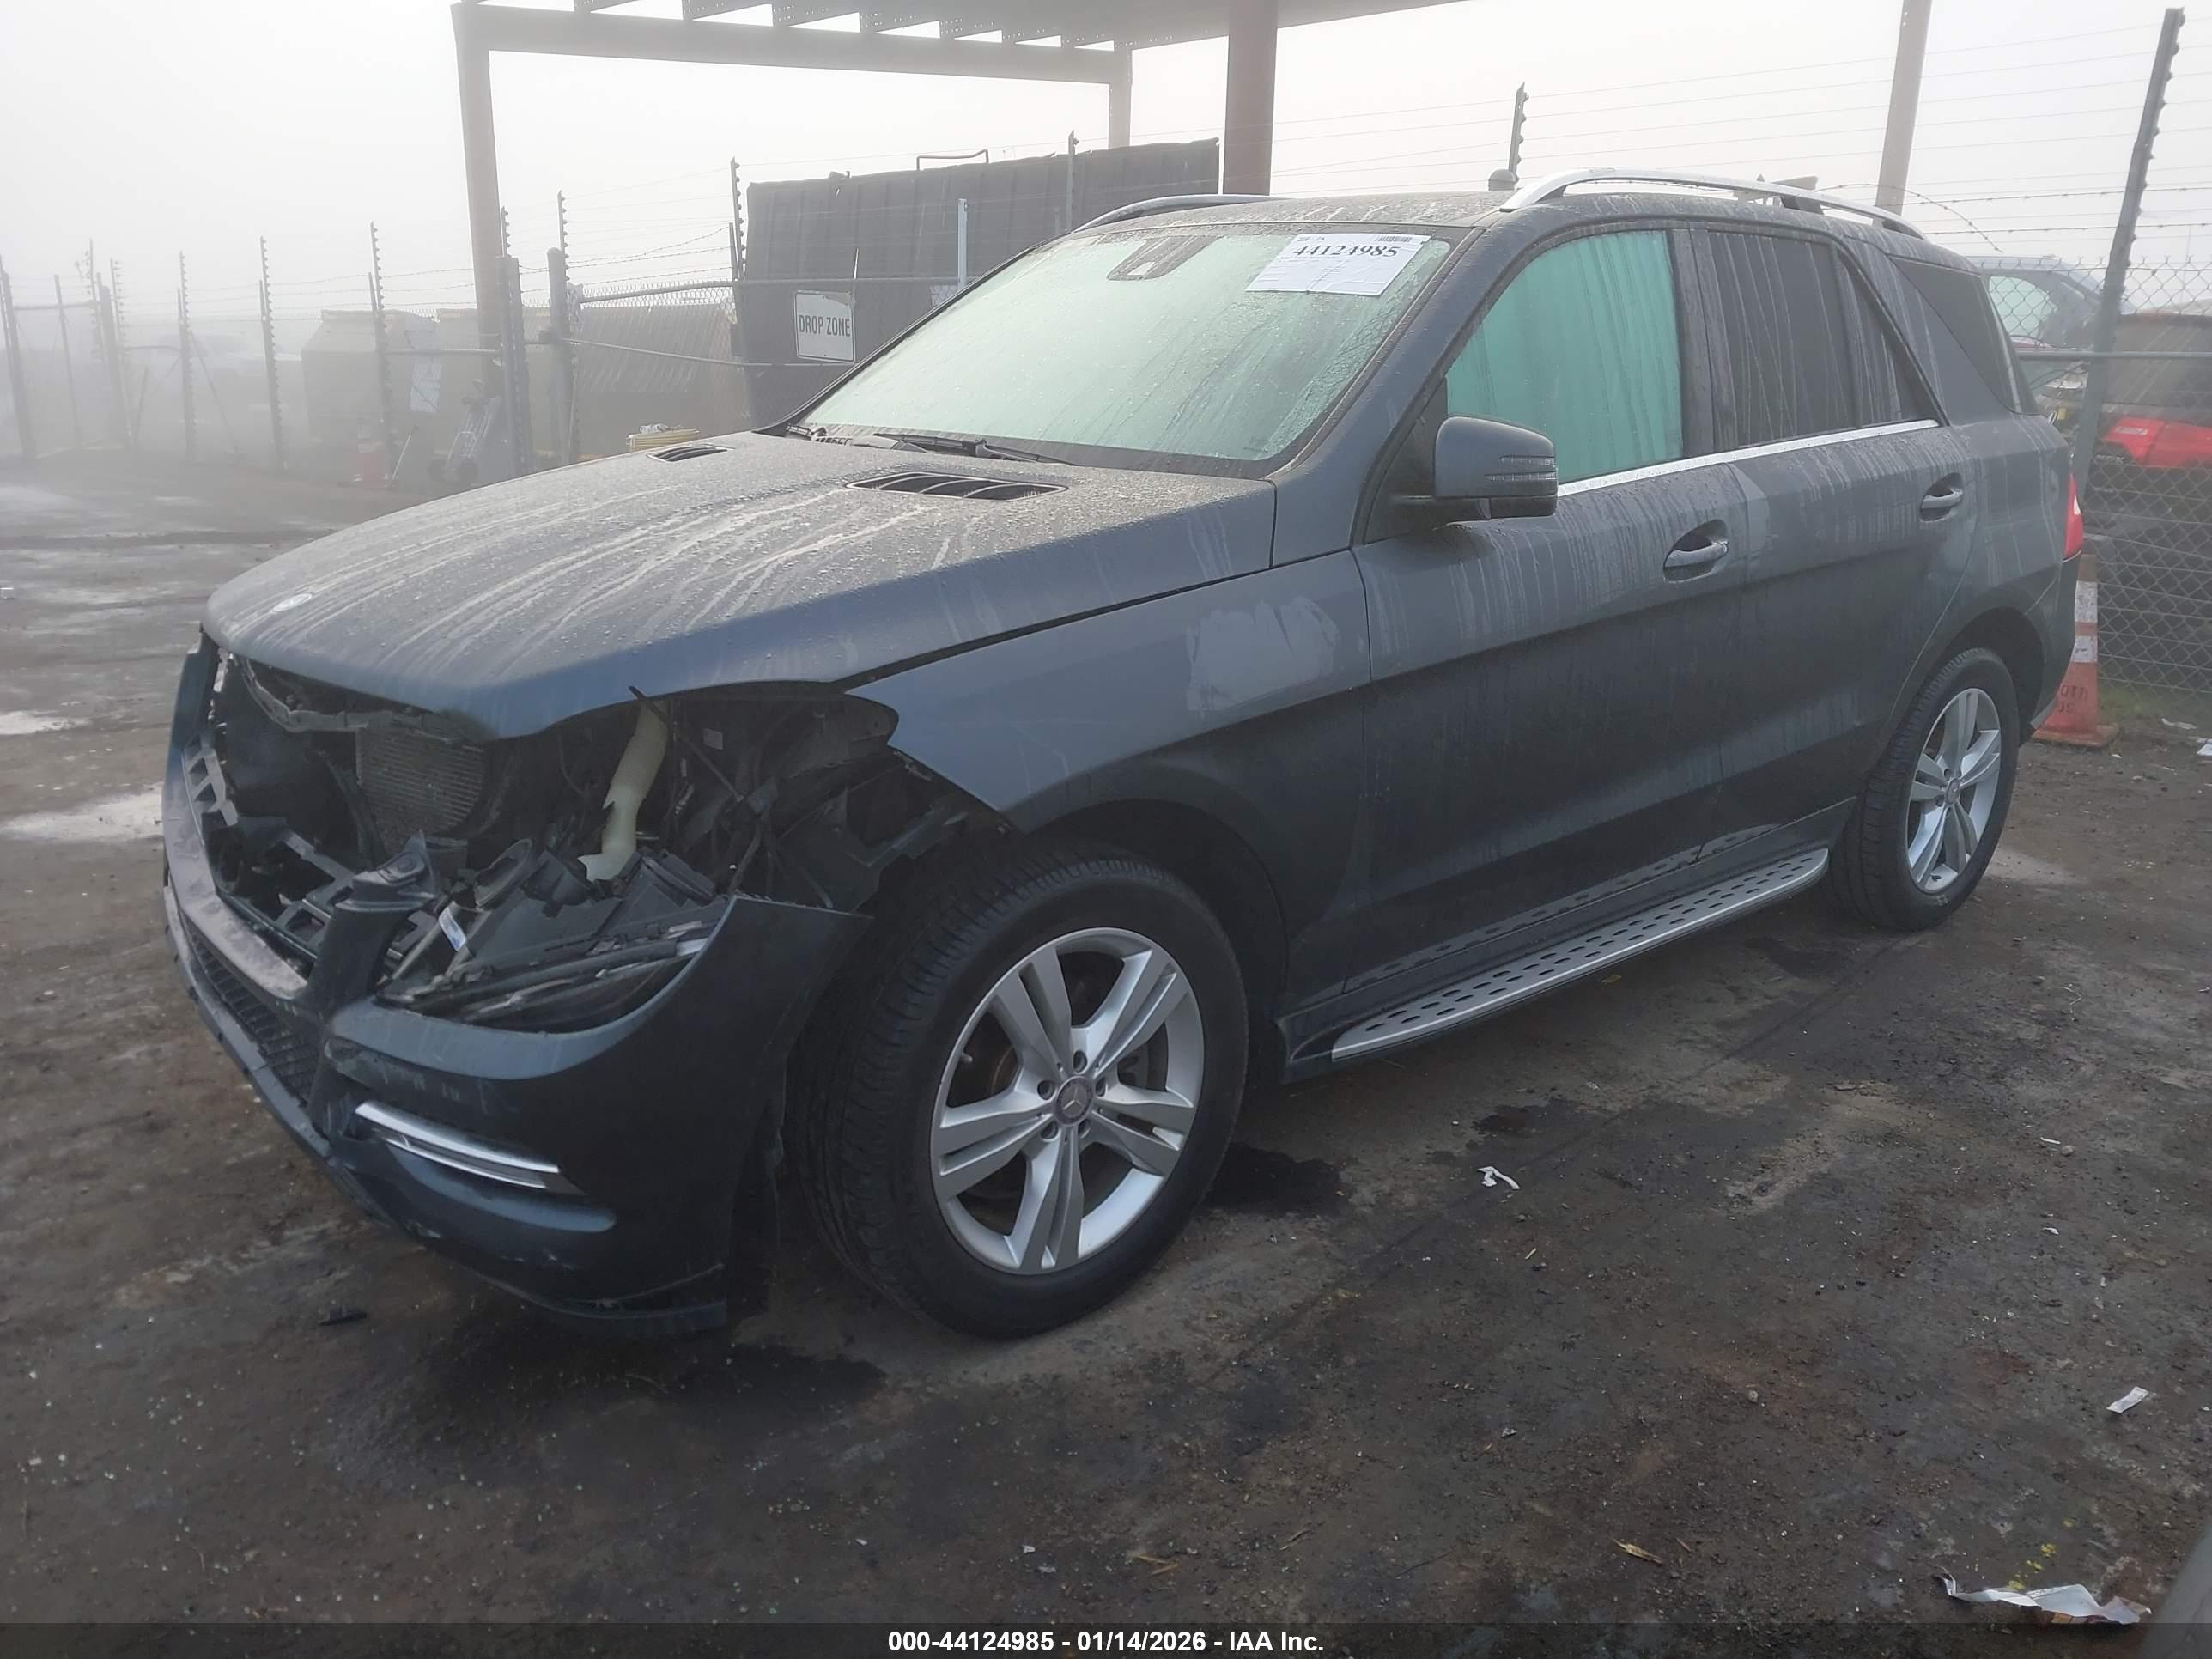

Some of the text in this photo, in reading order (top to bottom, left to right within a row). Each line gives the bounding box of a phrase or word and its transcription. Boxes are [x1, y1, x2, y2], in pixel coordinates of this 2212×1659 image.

[1293, 245, 1401, 258] 44124985
[799, 314, 851, 337] DROP ZONE
